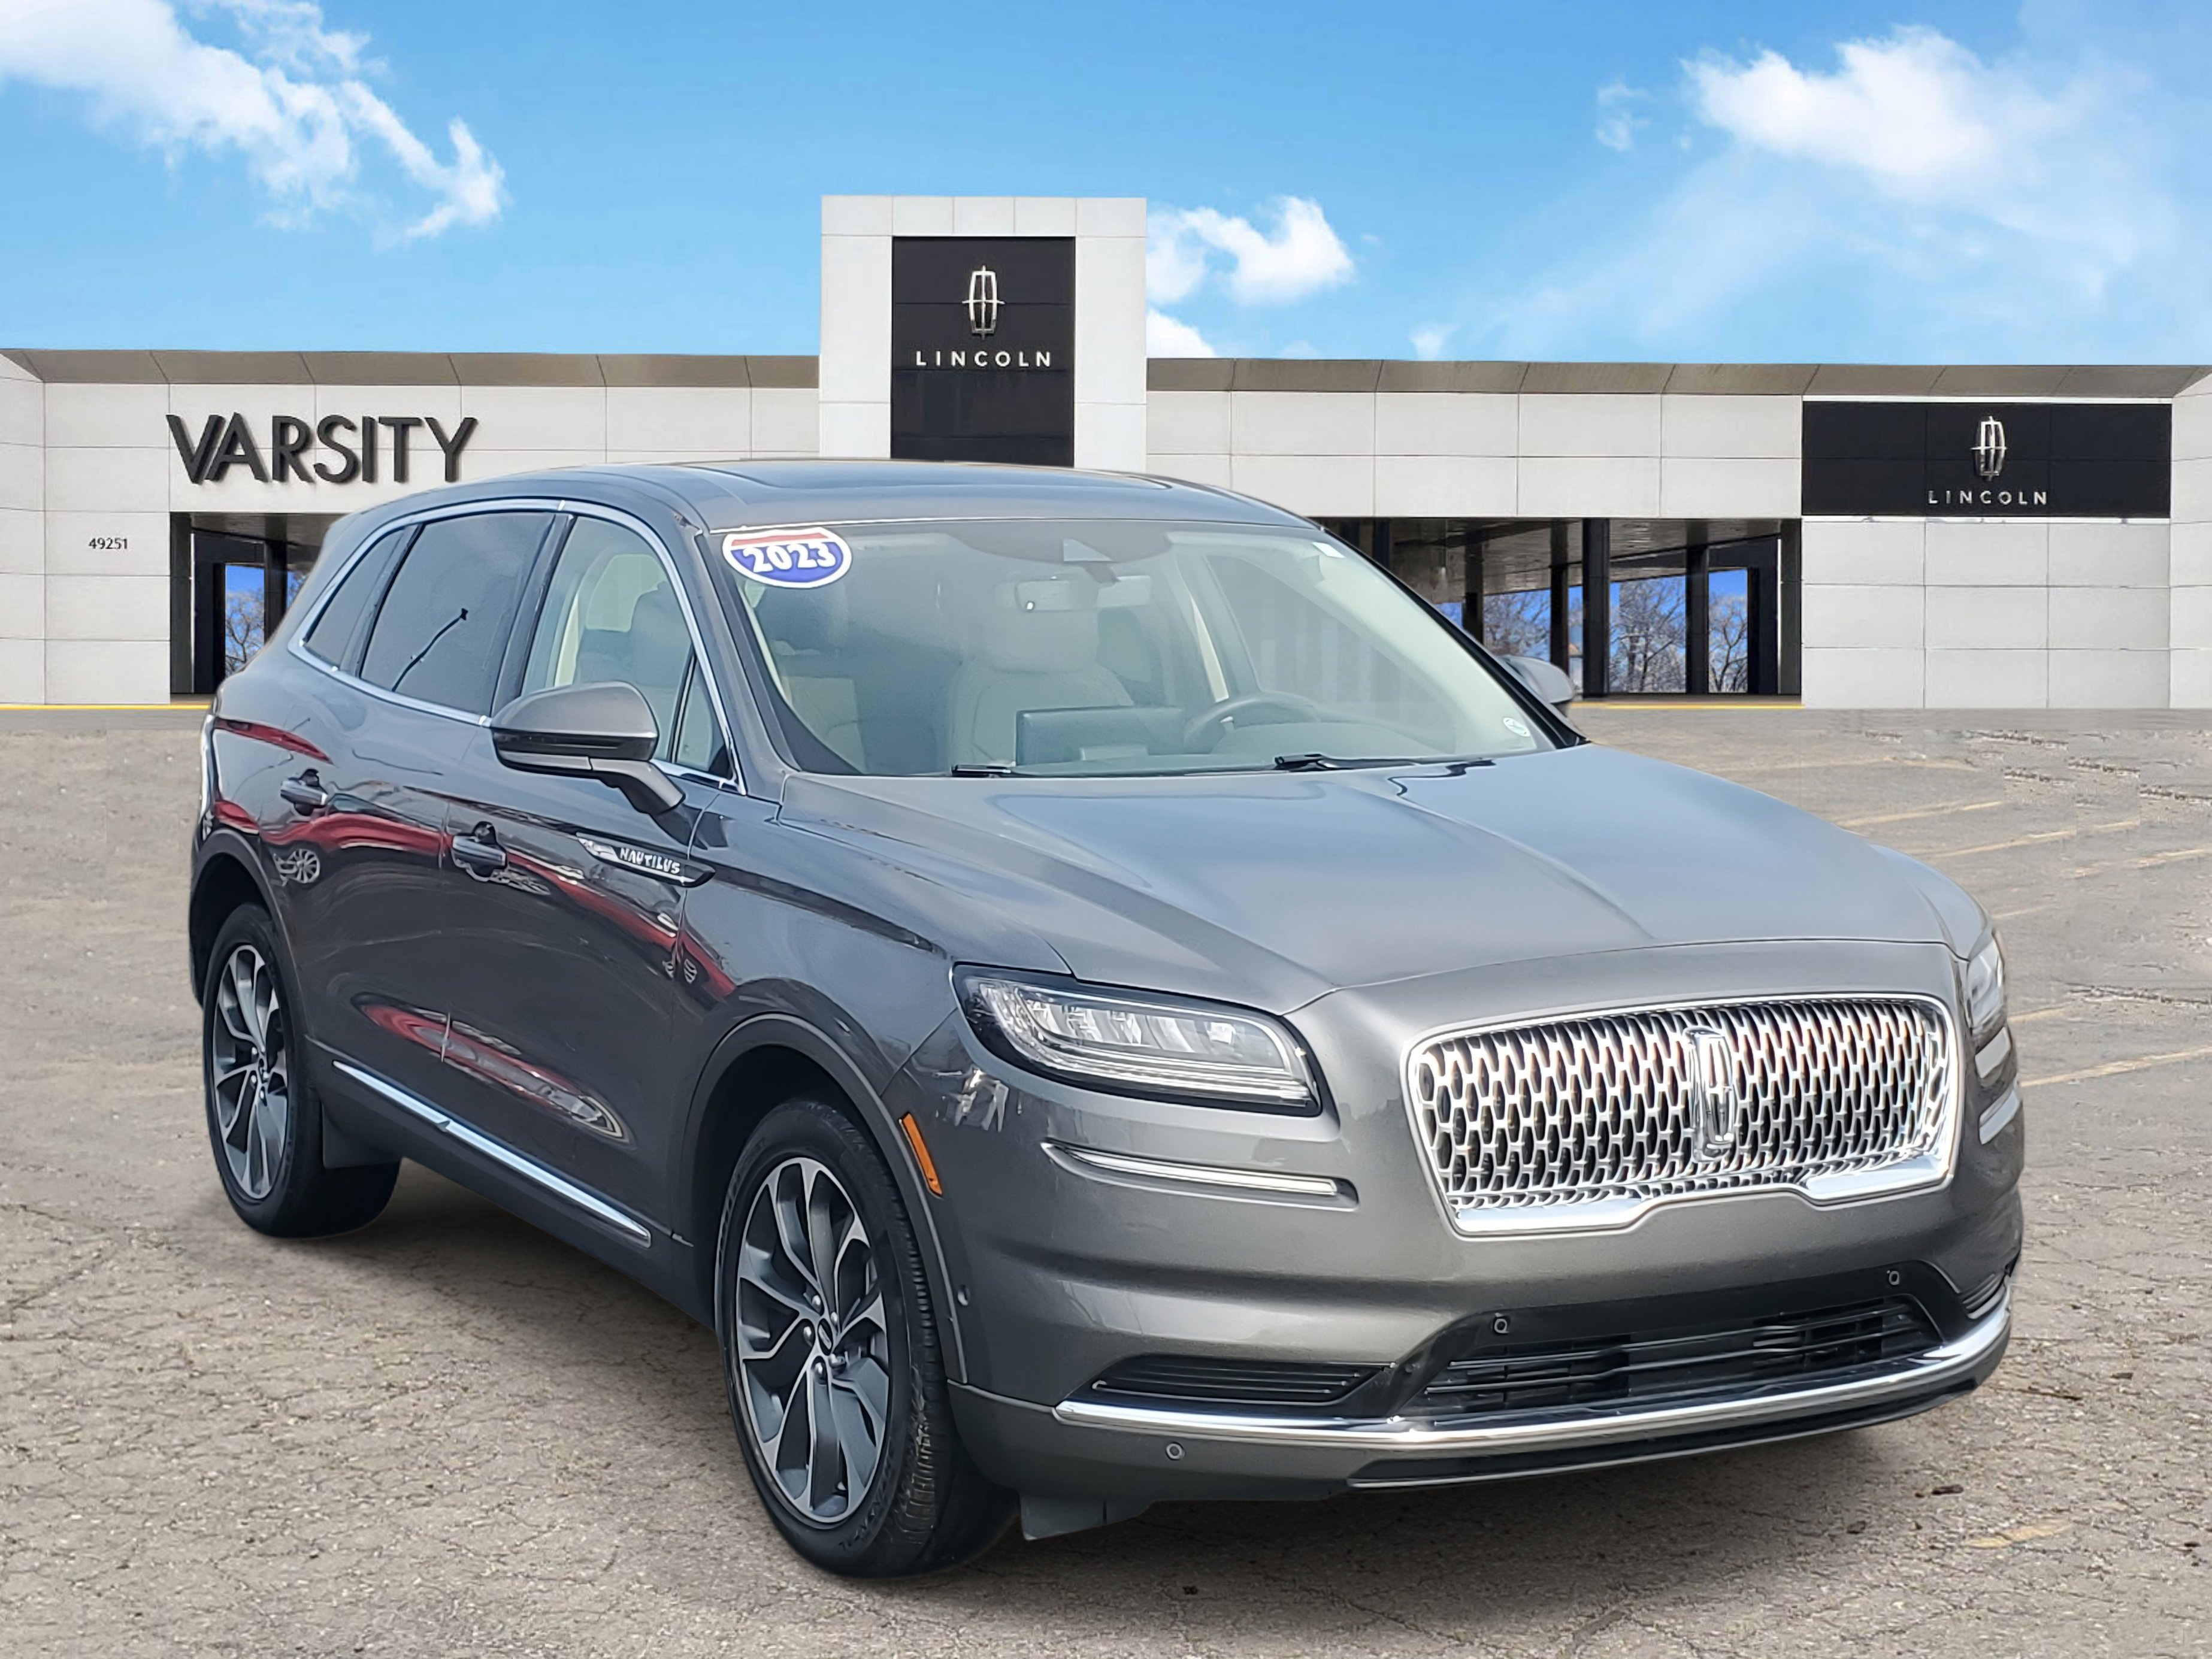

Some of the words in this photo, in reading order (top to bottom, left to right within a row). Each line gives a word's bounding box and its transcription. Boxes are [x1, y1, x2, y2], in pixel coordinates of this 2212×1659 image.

[916, 350, 1051, 367] LINCOLN
[166, 412, 478, 484] VARSITY
[1928, 491, 2047, 505] LINCOLN
[88, 537, 128, 549] 49251
[743, 542, 836, 573] 2023
[619, 847, 680, 874] NAUTILUS
